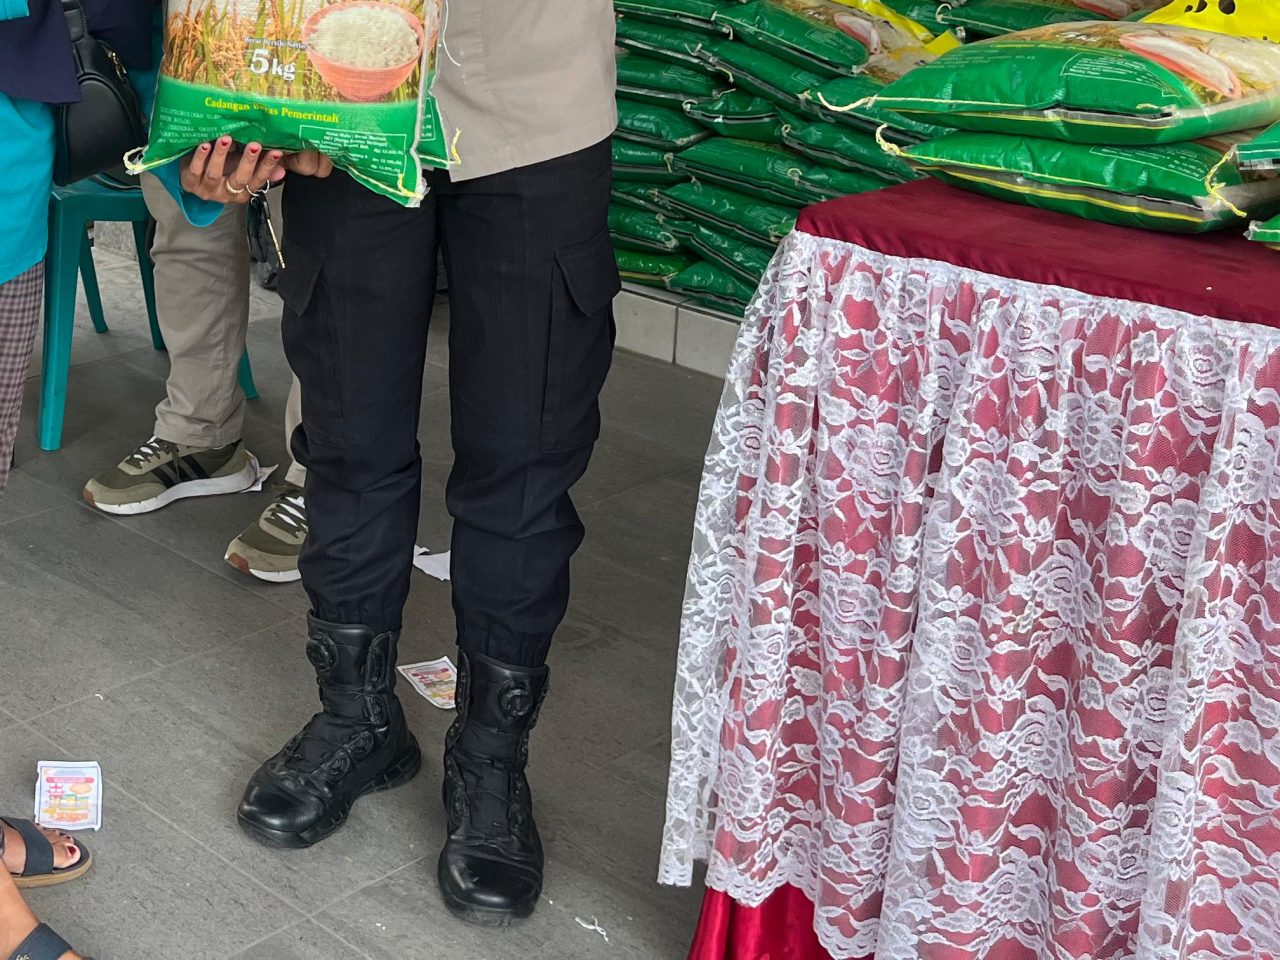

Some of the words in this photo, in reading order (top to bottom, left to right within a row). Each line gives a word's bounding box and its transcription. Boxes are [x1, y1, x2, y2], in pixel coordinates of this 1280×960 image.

[250, 48, 269, 74] 5
[271, 58, 295, 80] kg
[204, 96, 250, 113] Cadangan
[281, 107, 339, 124] Pemerintah
